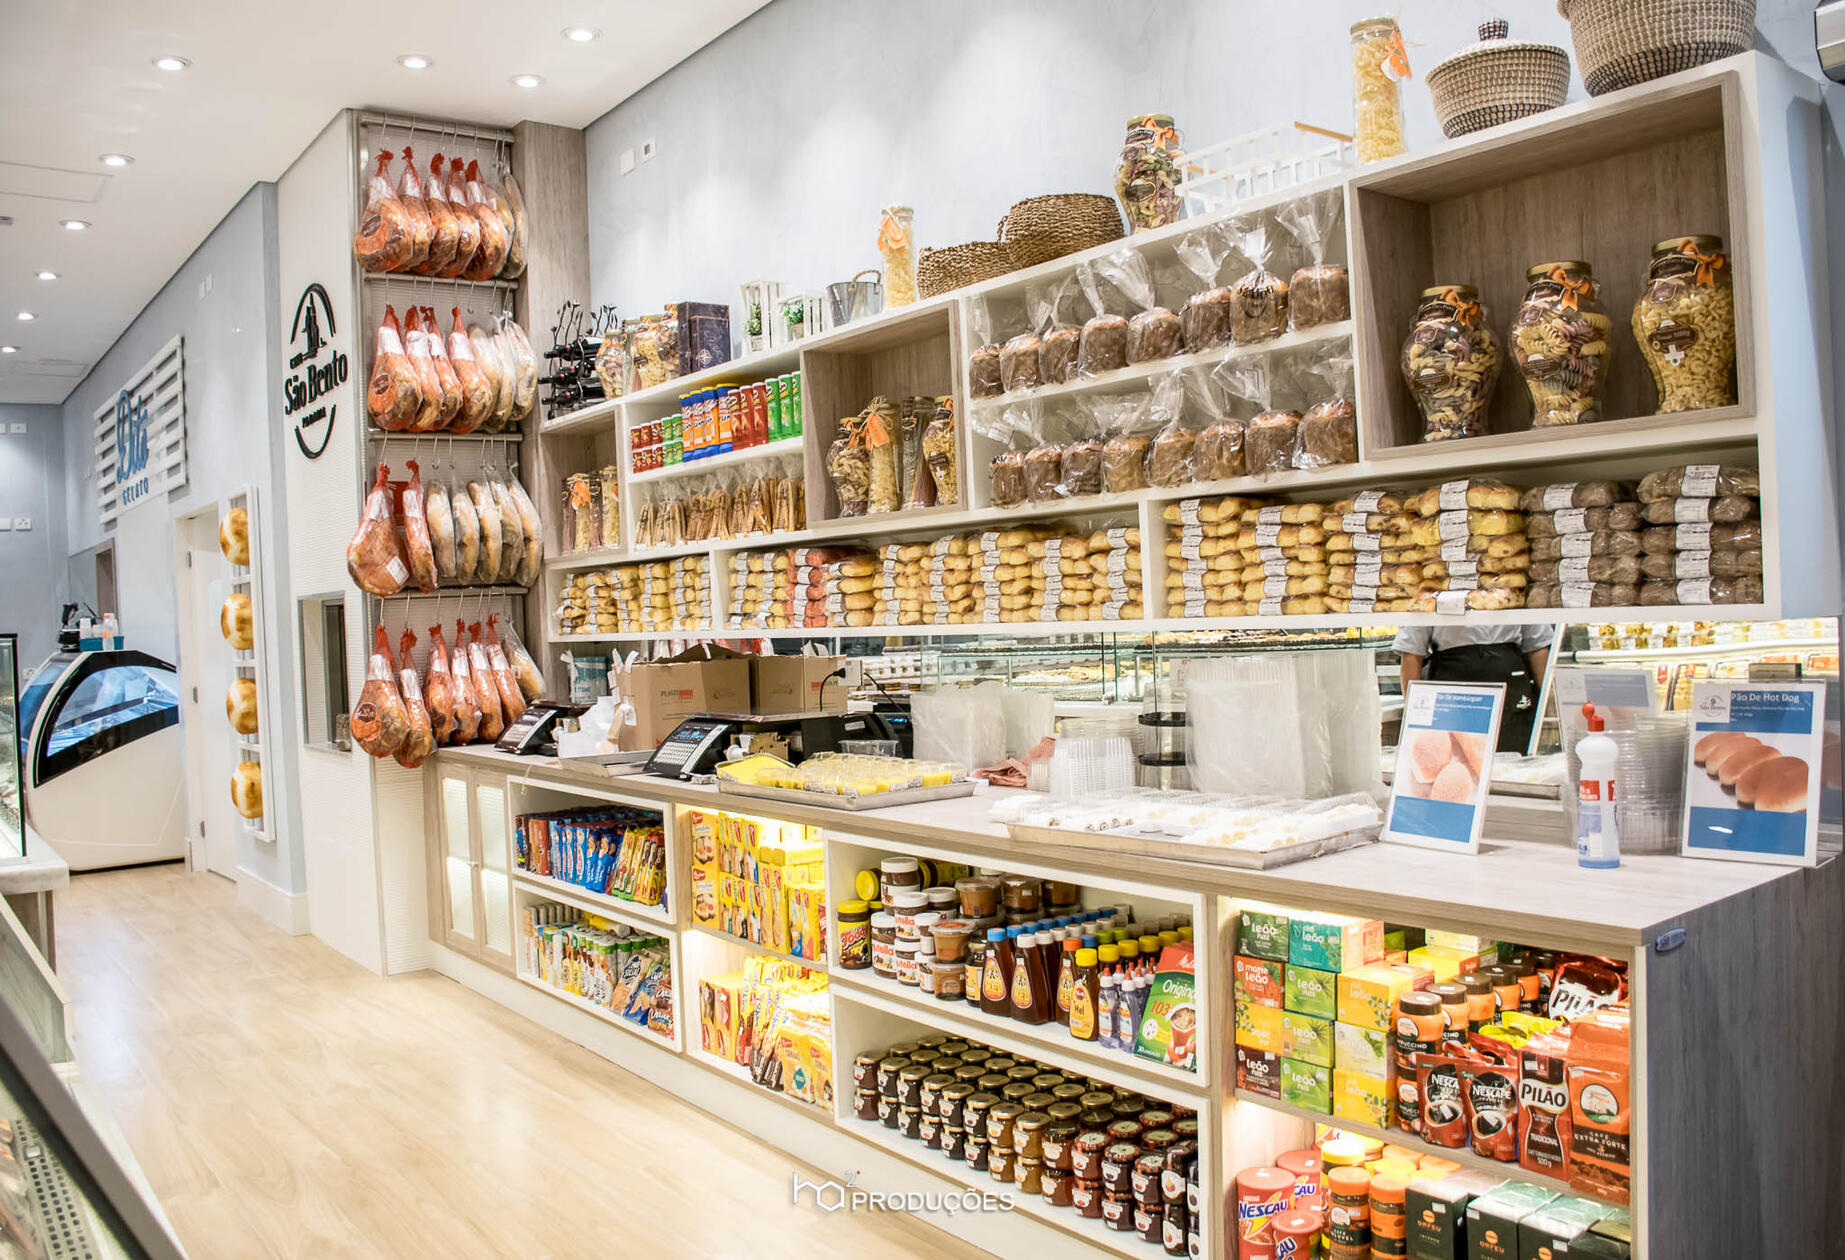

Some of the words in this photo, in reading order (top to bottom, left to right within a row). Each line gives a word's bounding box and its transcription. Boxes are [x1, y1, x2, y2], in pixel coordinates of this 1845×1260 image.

[285, 374, 307, 415] São
[307, 350, 348, 403] Bento
[122, 477, 149, 505] GELATO
[1731, 692, 1747, 702] Pão
[1749, 694, 1761, 702] De
[1763, 693, 1779, 702] Hot
[1781, 694, 1800, 703] Dog
[895, 915, 916, 926] tella
[839, 926, 869, 948] Toddy
[873, 943, 895, 956] utella
[896, 959, 918, 970] tella
[1245, 971, 1269, 984] leão
[1151, 1000, 1171, 1016] 103
[1246, 1058, 1269, 1073] leão
[1431, 1074, 1458, 1089] NESCA
[1521, 1082, 1567, 1108] PILÃO
[1238, 1199, 1288, 1219] NESCAU
